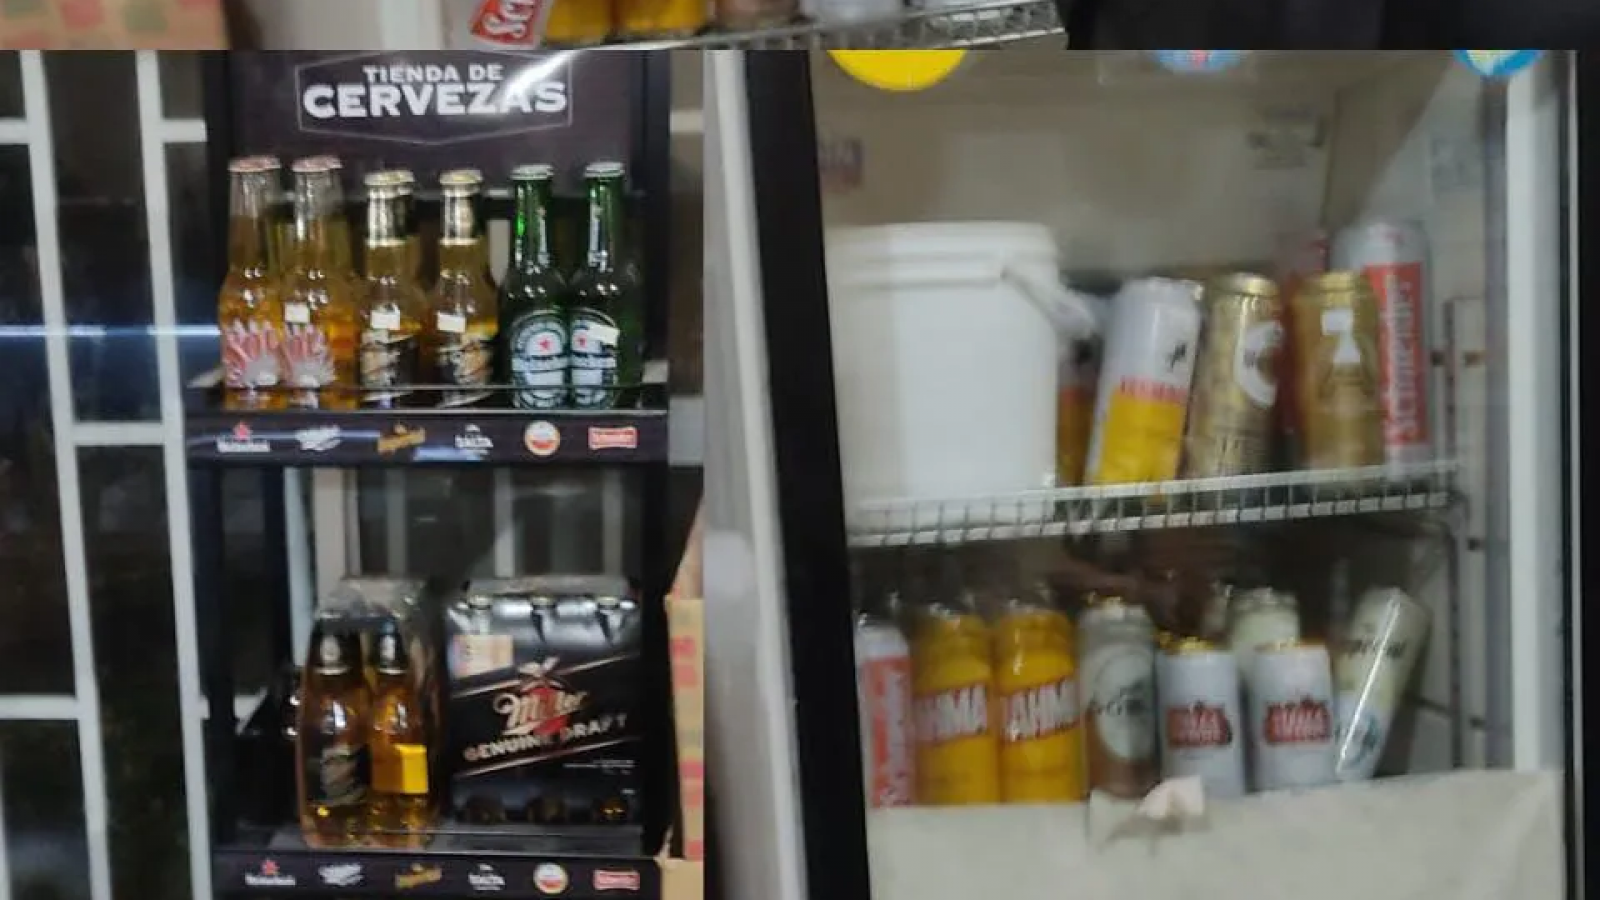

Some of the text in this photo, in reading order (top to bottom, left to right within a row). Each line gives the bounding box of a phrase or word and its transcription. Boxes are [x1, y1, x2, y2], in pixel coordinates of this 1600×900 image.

[482, 0, 534, 39] Sc
[362, 63, 505, 83] TIENDA DE
[303, 81, 567, 118] CERVEZAS
